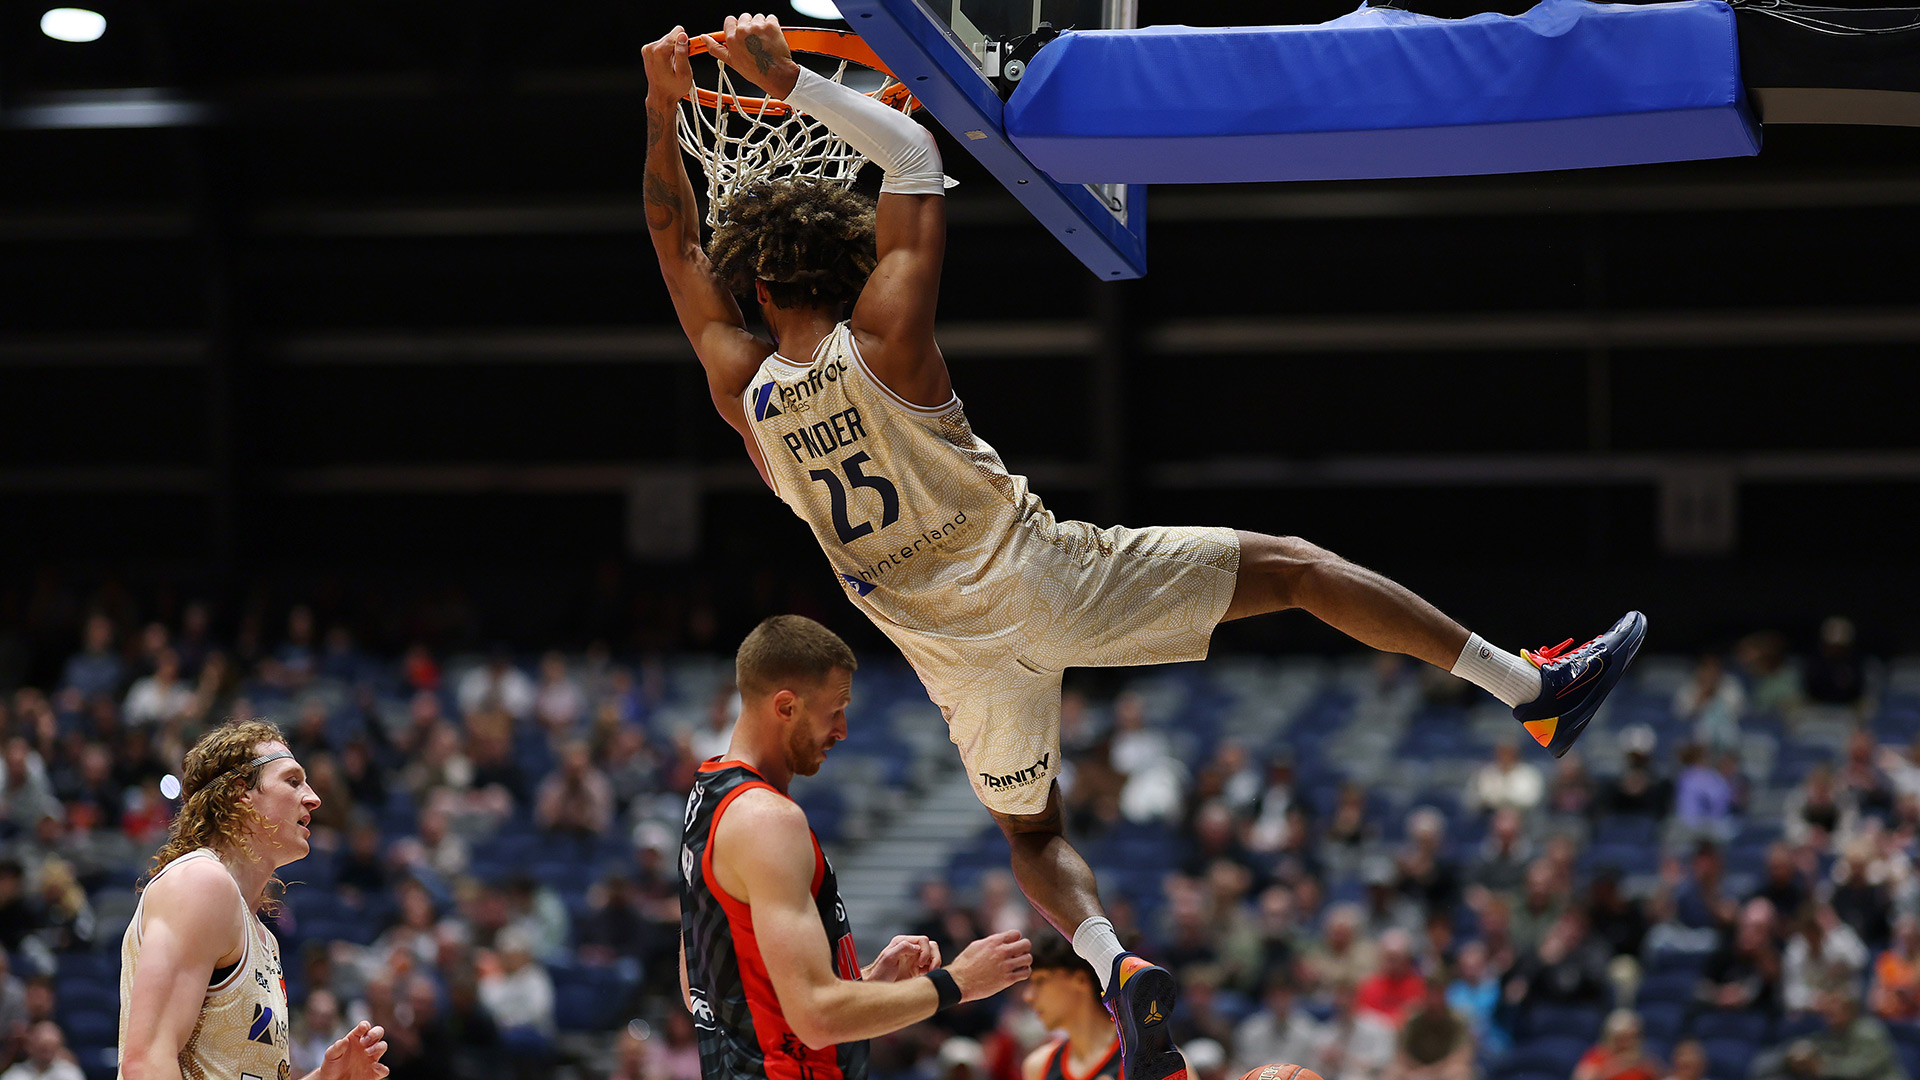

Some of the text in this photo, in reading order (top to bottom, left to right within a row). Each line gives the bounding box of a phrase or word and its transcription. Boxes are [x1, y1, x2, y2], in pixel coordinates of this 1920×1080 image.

[809, 450, 899, 545] 25
[858, 511, 967, 581] hinterland
[980, 752, 1050, 789] TRINITY
[994, 771, 1046, 793] AUTO GROUP
